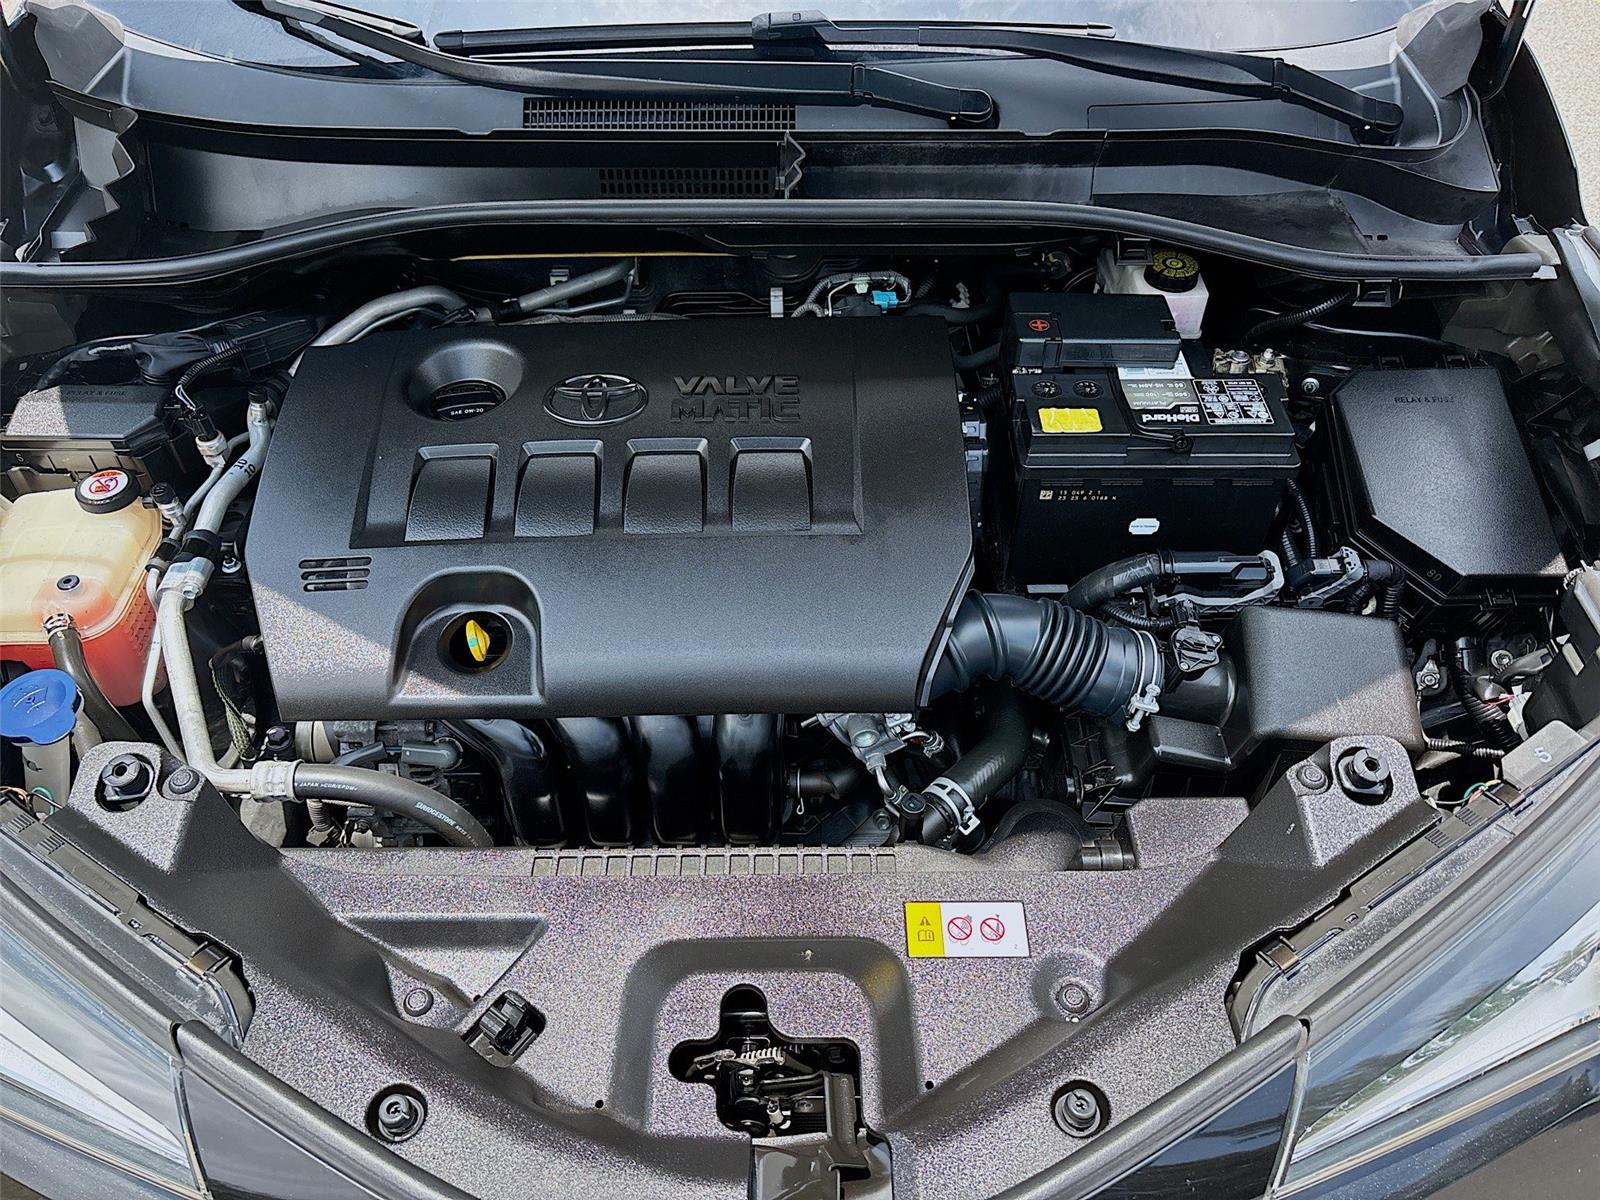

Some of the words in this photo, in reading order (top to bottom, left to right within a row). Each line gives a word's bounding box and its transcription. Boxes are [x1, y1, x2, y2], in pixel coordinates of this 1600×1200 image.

[673, 375, 800, 396] VALVE
[670, 397, 801, 422] MATIC
[1141, 413, 1201, 423] DieHard
[233, 458, 248, 470] 10
[244, 463, 257, 479] 10
[415, 801, 457, 827] BRIDGESTONE
